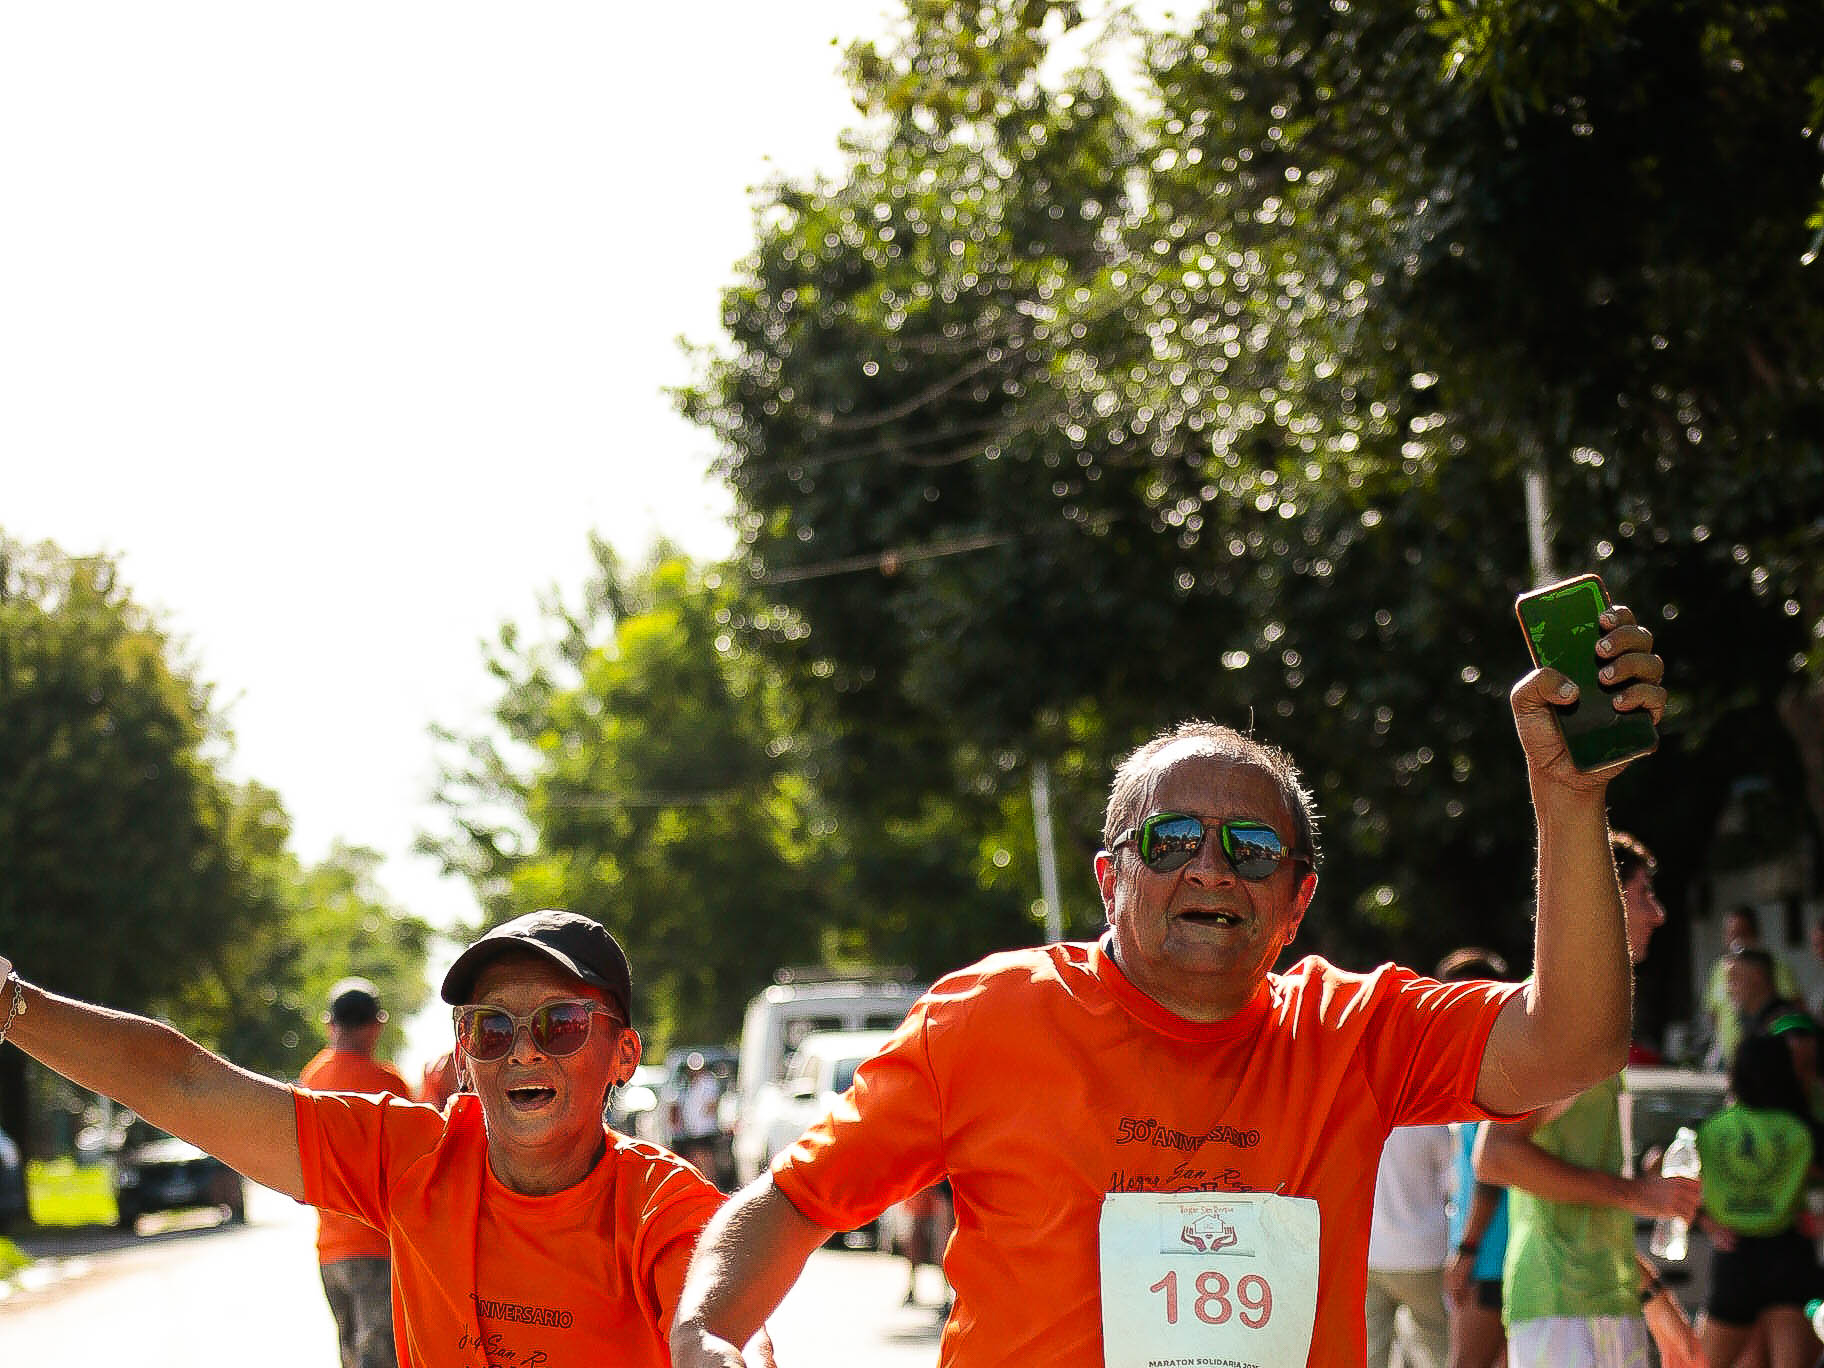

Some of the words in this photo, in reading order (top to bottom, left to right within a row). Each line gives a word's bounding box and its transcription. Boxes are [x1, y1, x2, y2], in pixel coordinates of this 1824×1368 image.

[477, 1299, 574, 1329] NIVERSARIO
[1149, 1270, 1273, 1330] 189
[1148, 1359, 1194, 1368] MARATON
[1196, 1358, 1241, 1368] SOLIDARIA
